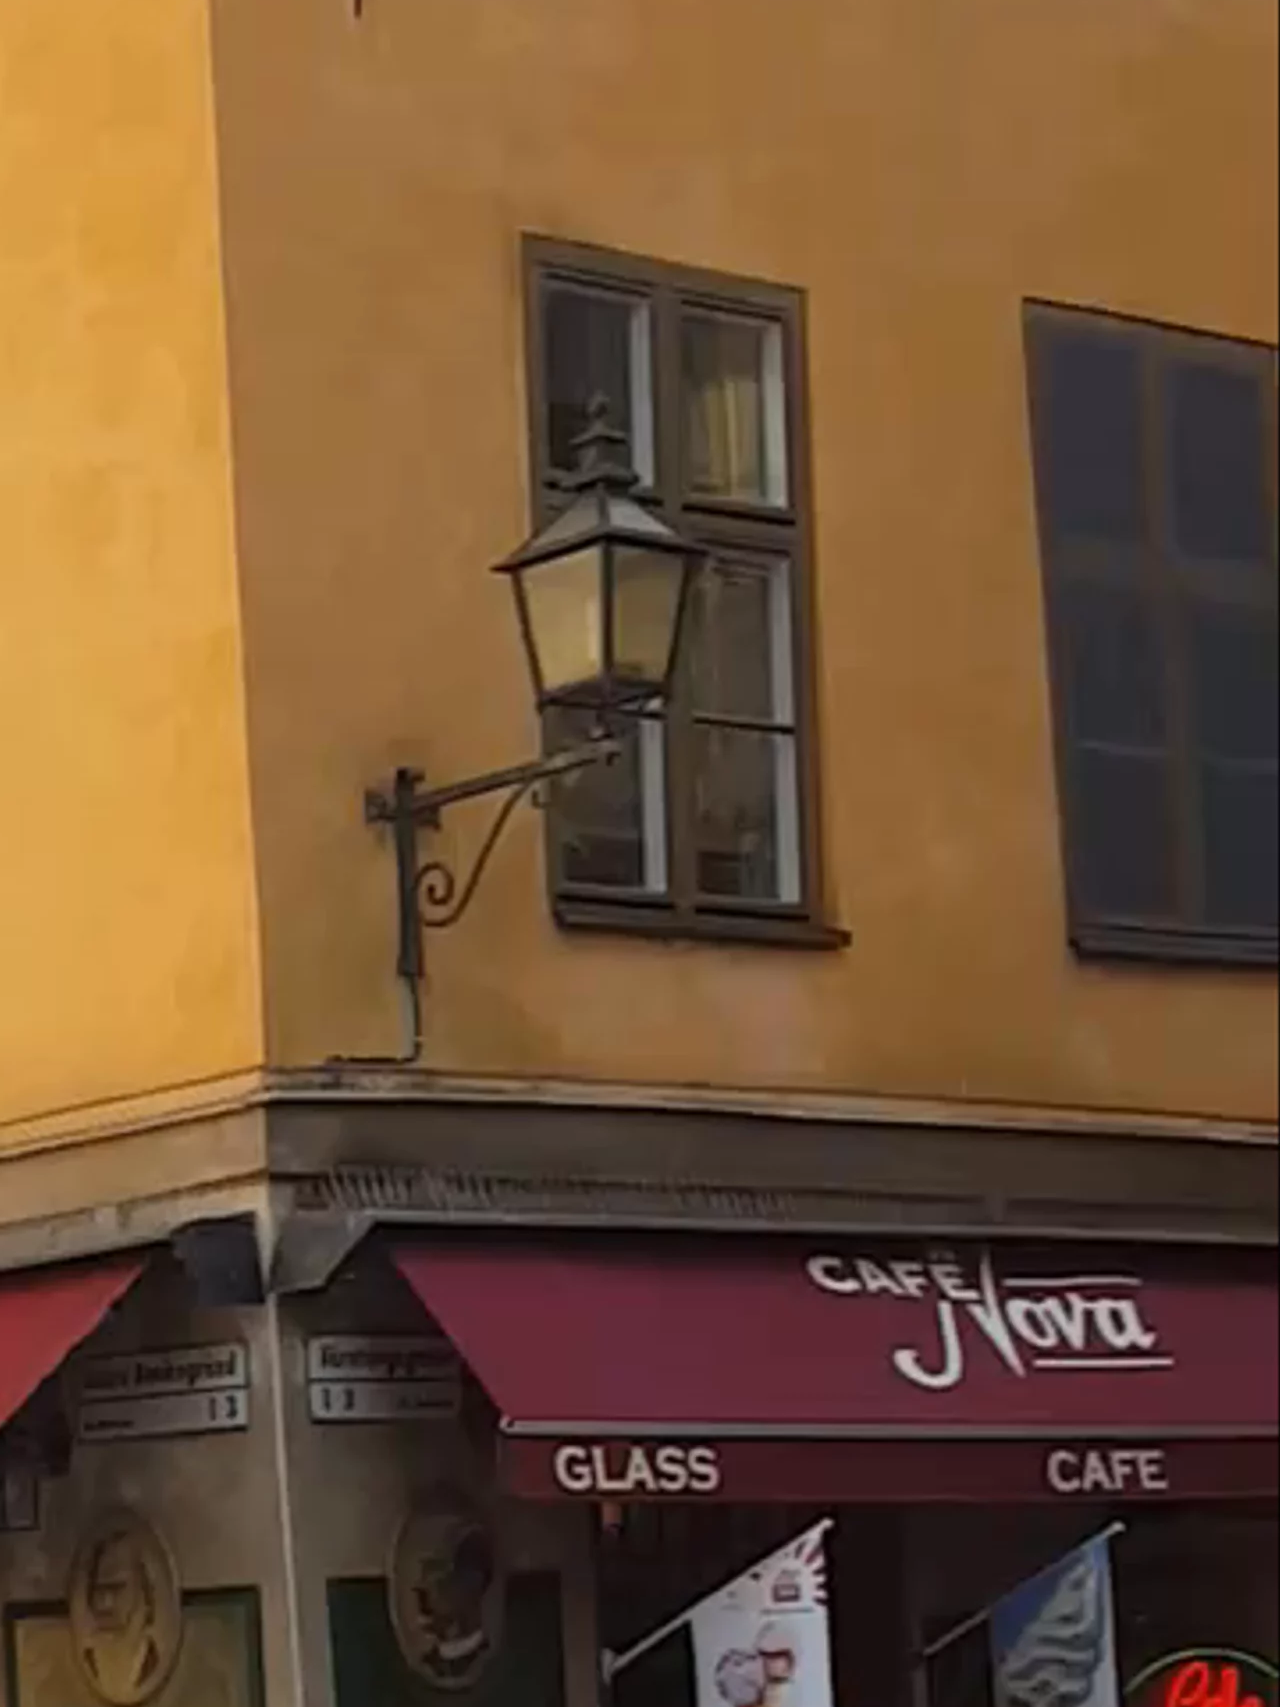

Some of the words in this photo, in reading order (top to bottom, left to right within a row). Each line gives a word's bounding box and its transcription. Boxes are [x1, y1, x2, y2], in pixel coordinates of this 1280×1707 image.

[894, 1243, 1160, 1388] Nova
[554, 1446, 721, 1492] GLASS
[1047, 1449, 1169, 1492] CAFE
